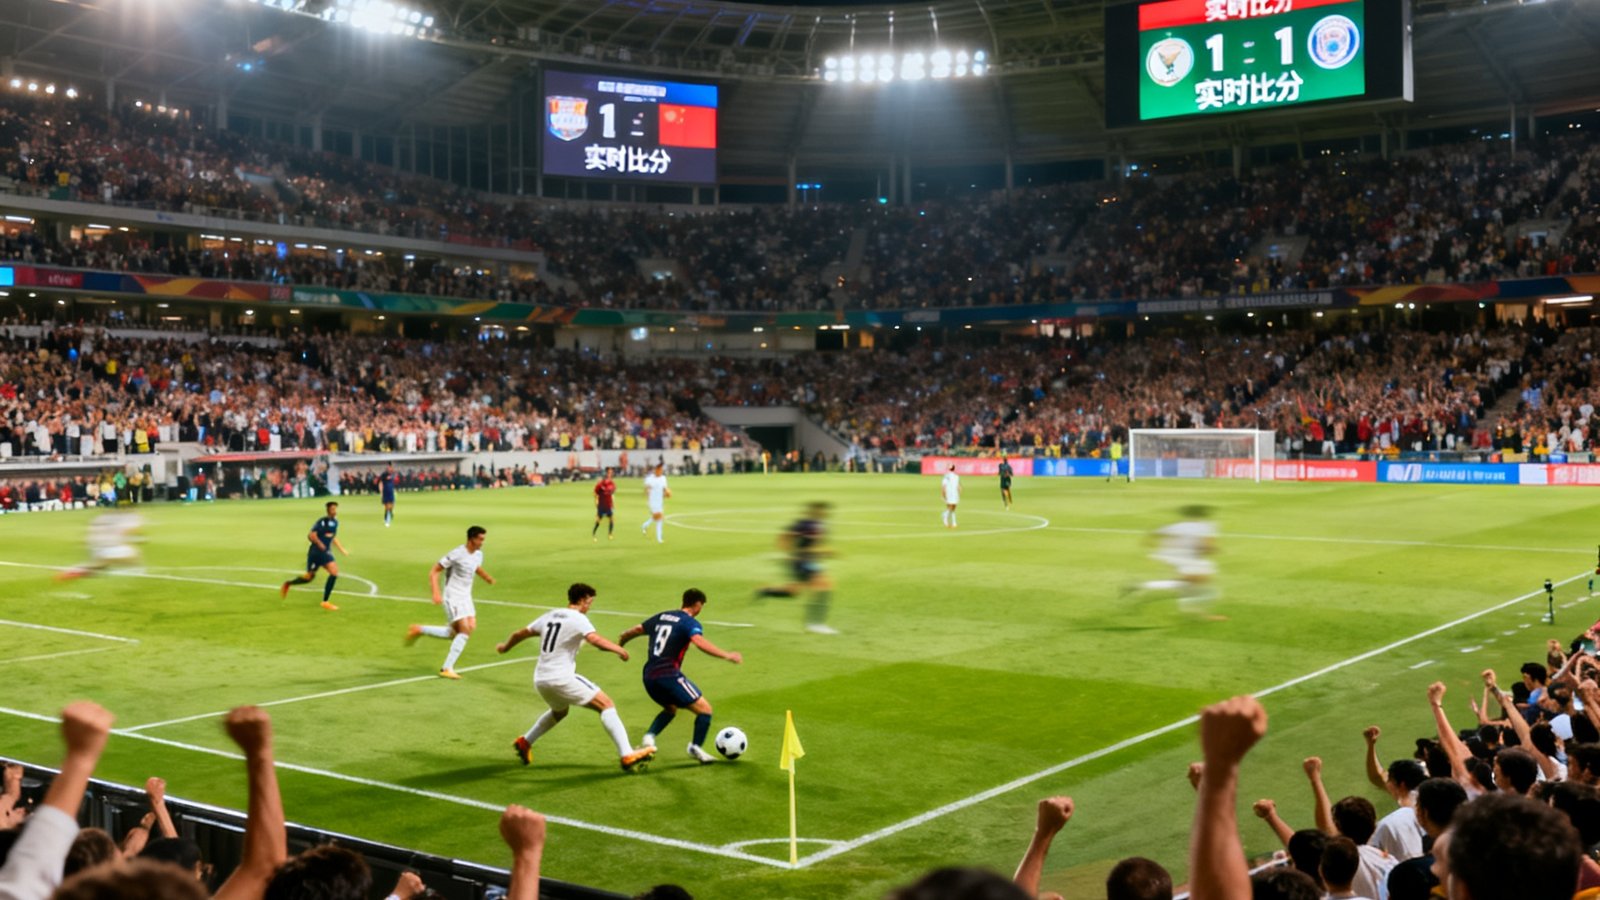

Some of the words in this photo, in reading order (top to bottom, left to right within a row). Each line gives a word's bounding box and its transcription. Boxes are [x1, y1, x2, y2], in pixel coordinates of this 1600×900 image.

[1205, 33, 1223, 71] 1
[1274, 26, 1293, 65] 1
[1194, 69, 1304, 110] 实时比分
[599, 103, 616, 138] 1
[584, 143, 671, 174] 实时比分
[542, 621, 561, 653] 11
